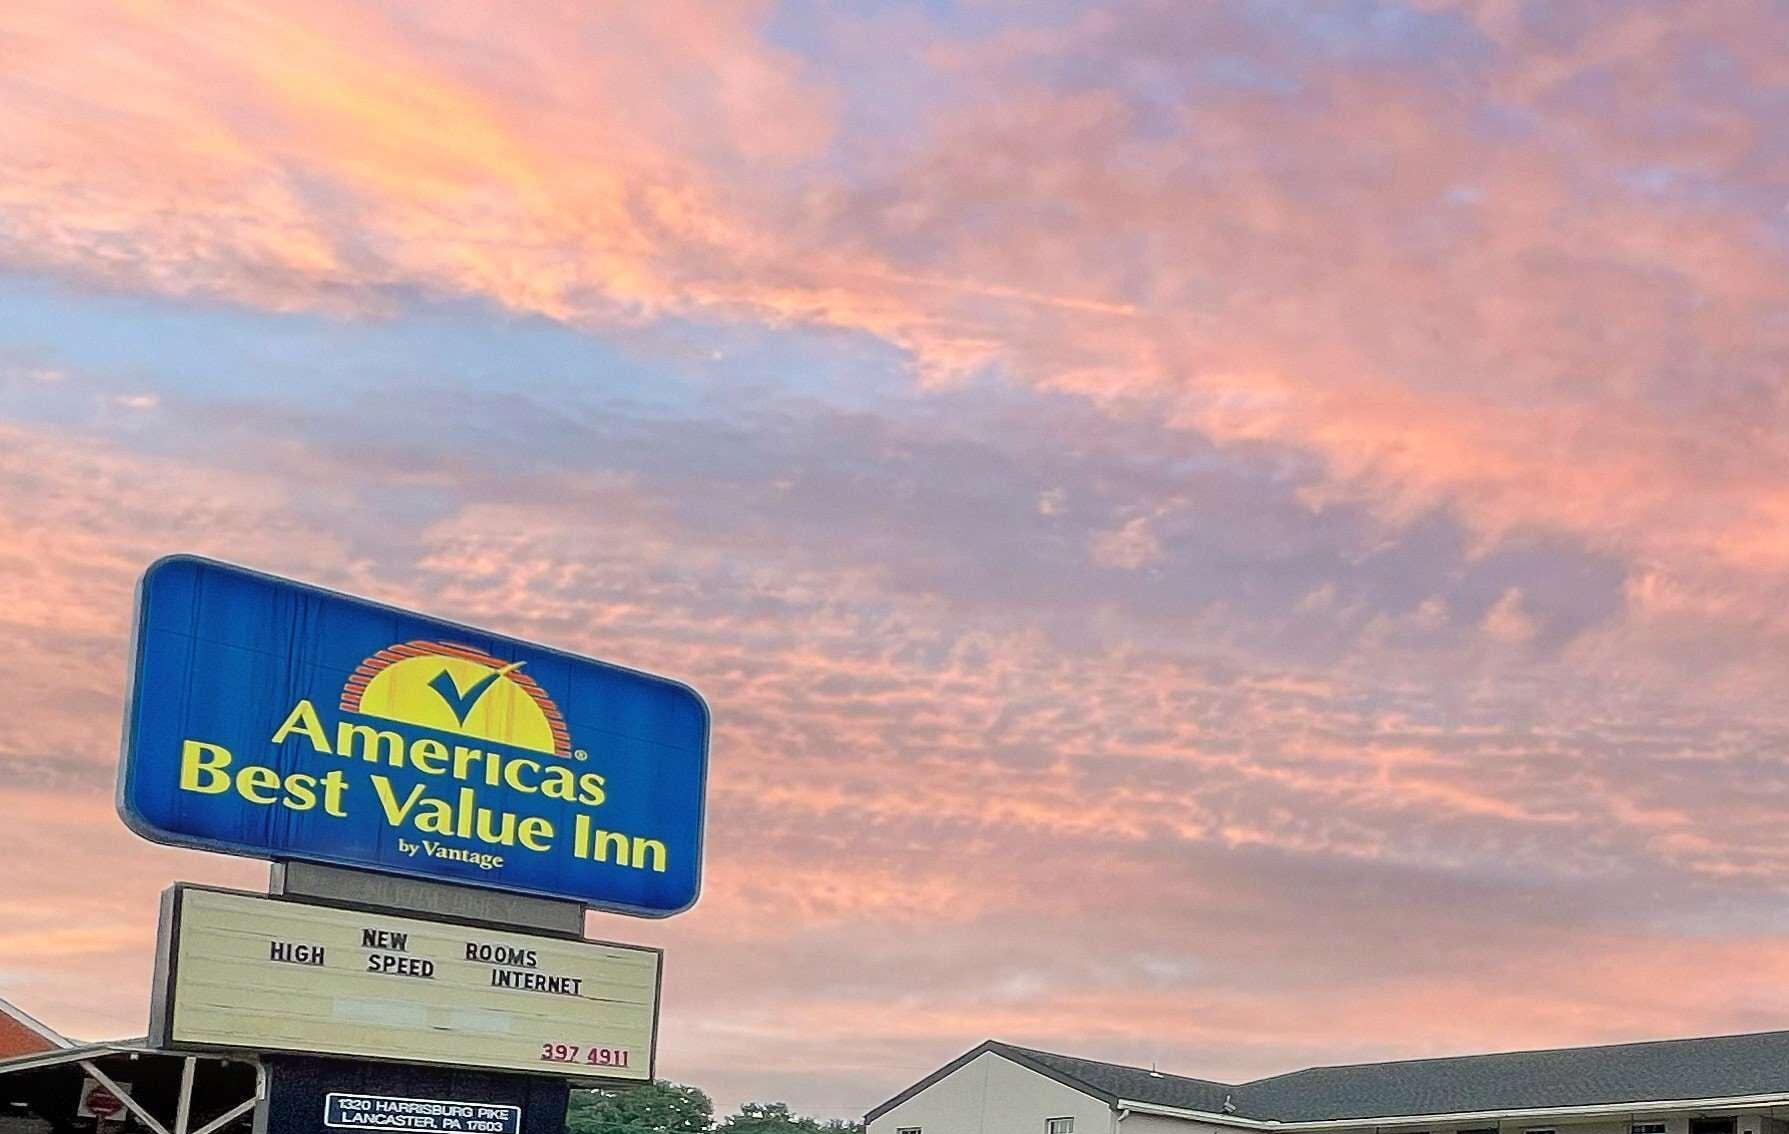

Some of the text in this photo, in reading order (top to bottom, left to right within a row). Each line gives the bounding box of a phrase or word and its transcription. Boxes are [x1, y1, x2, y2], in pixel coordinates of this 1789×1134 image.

[271, 699, 606, 807] Americas
[180, 739, 668, 873] Best Value Inn
[399, 838, 504, 870] by Vantage
[362, 929, 538, 968] NEW ROOMS
[270, 941, 583, 996] HIGH SPEED INTERNET
[541, 1043, 628, 1067] 397 4911
[338, 1098, 510, 1121] 1320 HARRISBURG PIKE
[442, 1118, 462, 1130] PA
[466, 1120, 504, 1133] 17603
